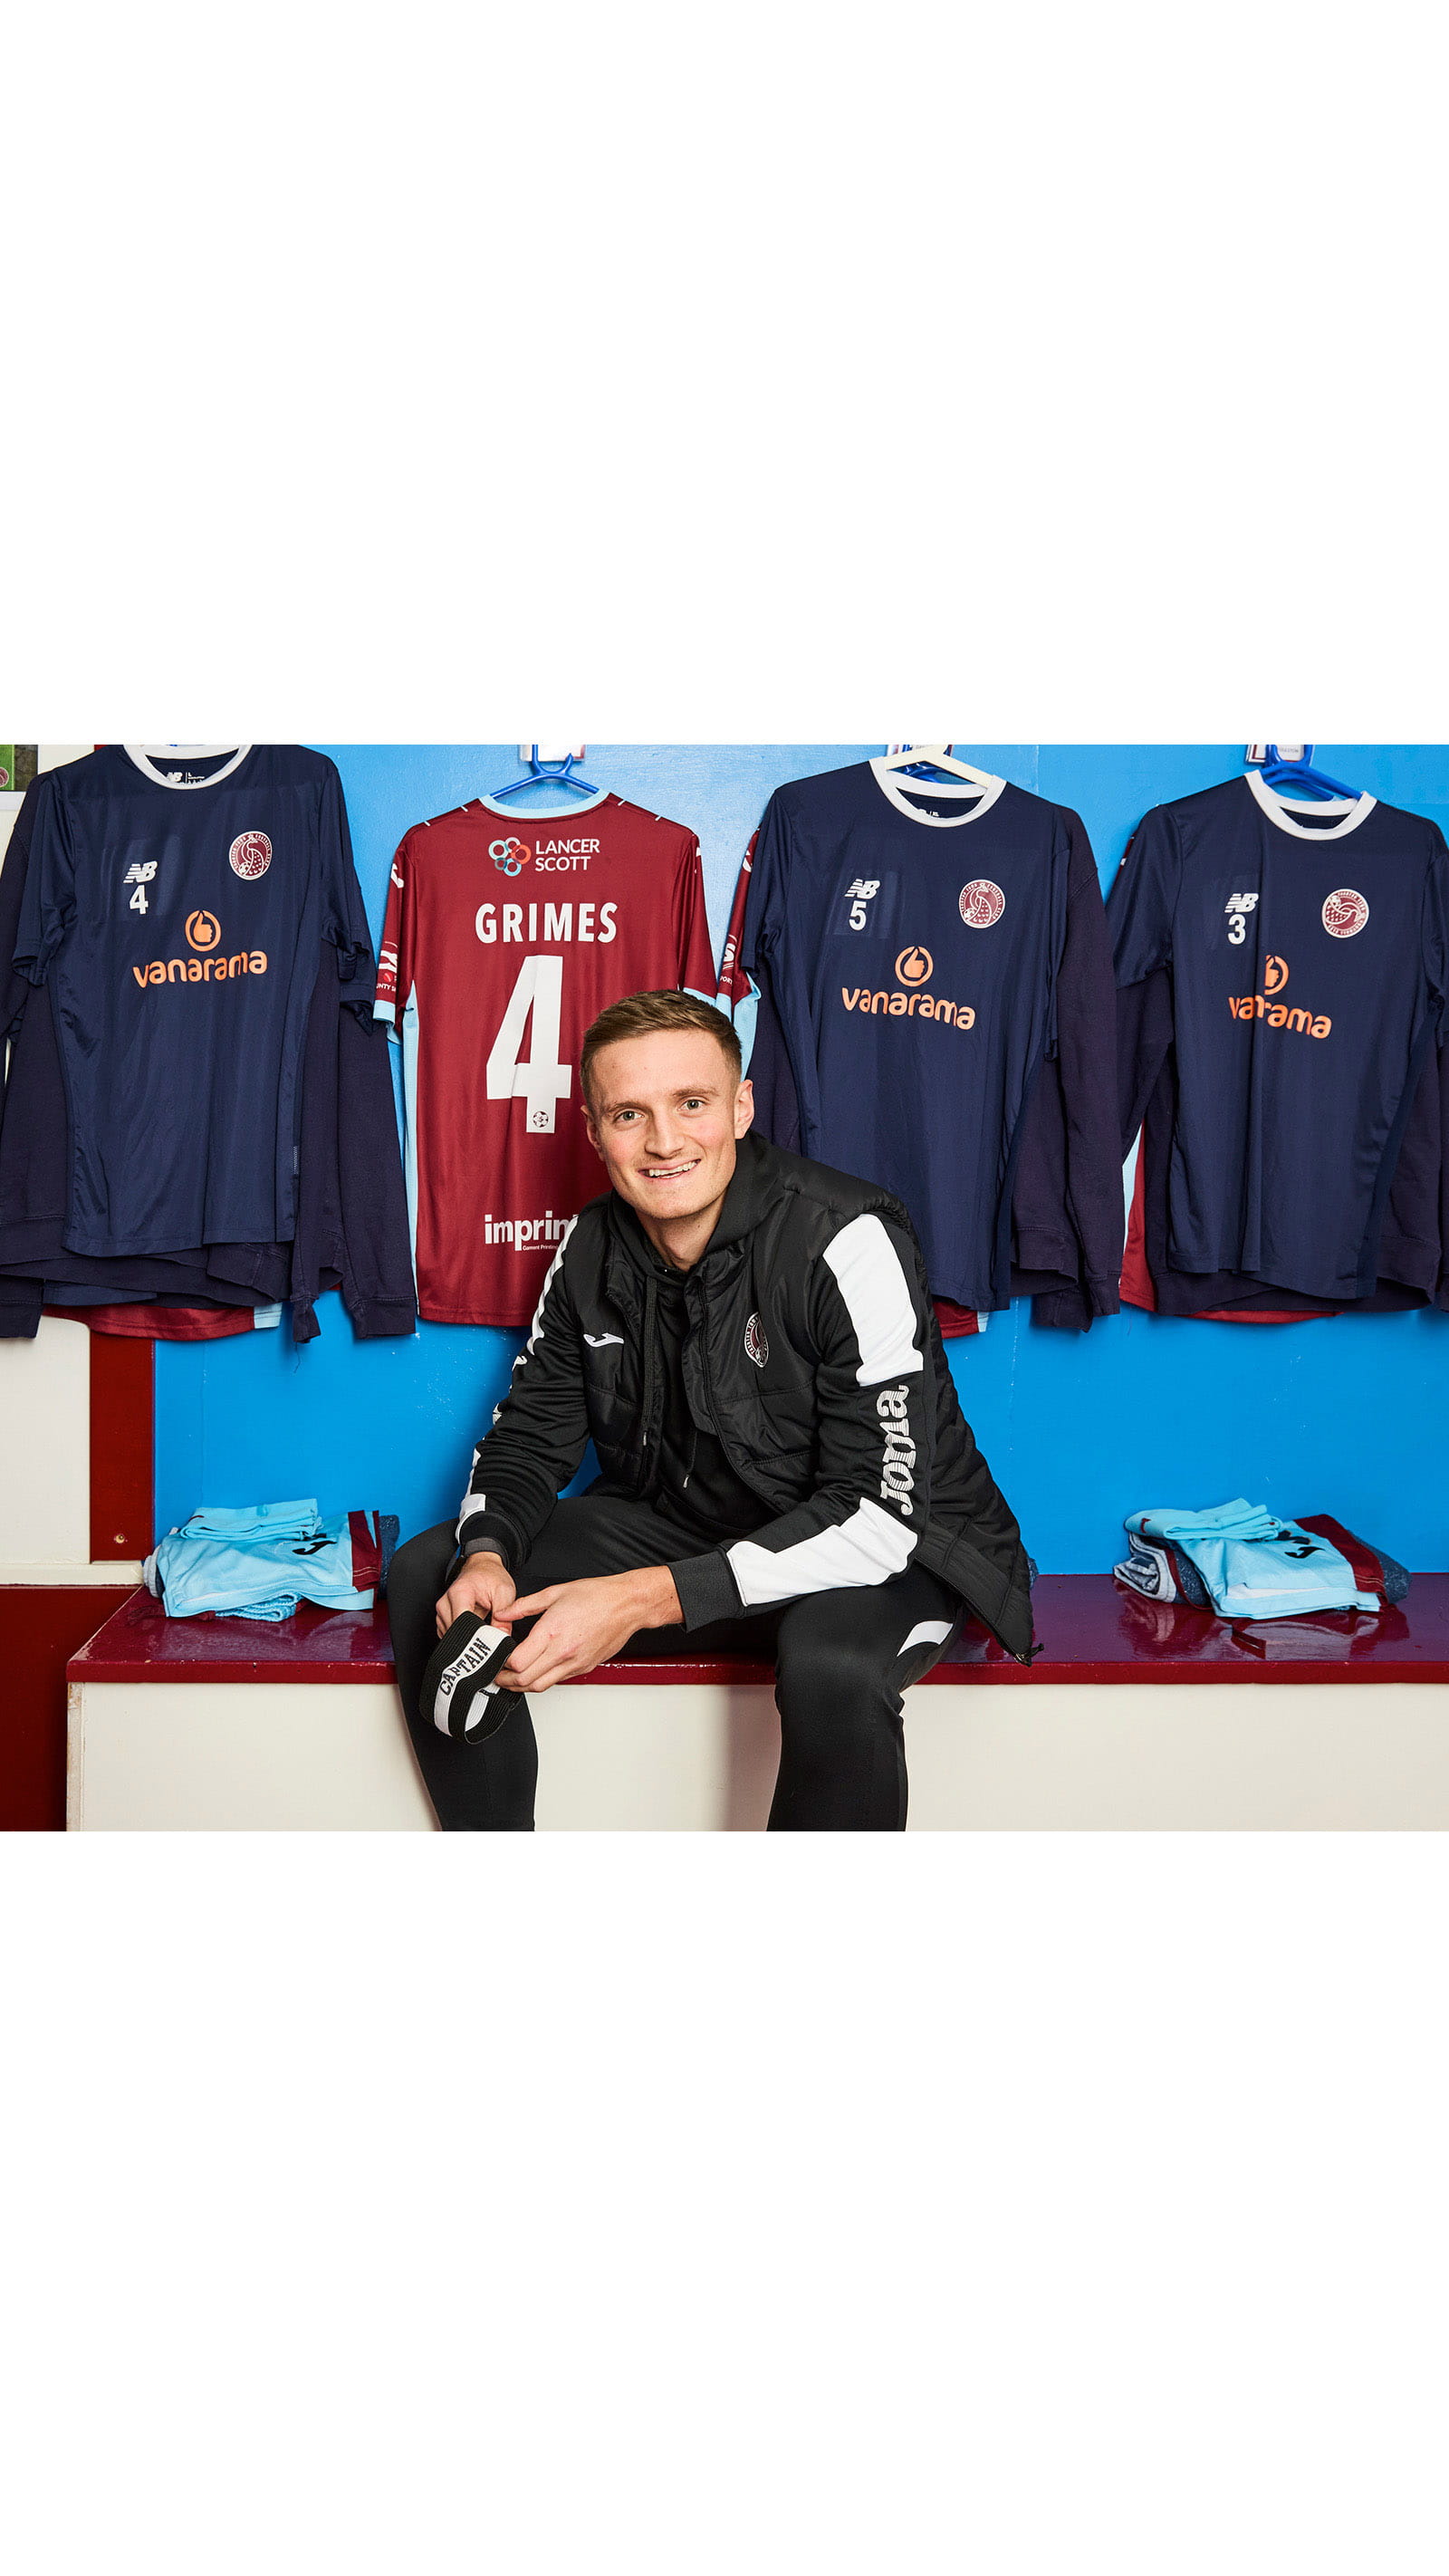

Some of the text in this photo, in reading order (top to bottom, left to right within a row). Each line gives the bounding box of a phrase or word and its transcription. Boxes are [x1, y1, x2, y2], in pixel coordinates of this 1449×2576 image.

[534, 855, 591, 872] SCOTT
[535, 838, 600, 855] LANCER
[129, 884, 149, 915] 4
[849, 899, 867, 931] 5
[475, 901, 618, 944] GRIMES
[1227, 914, 1246, 945] 3
[132, 950, 268, 988] vanarama
[841, 986, 975, 1031] vanarama
[485, 955, 572, 1134] 4
[485, 1210, 579, 1252] imprin
[439, 1638, 491, 1696] CAPTAIN
